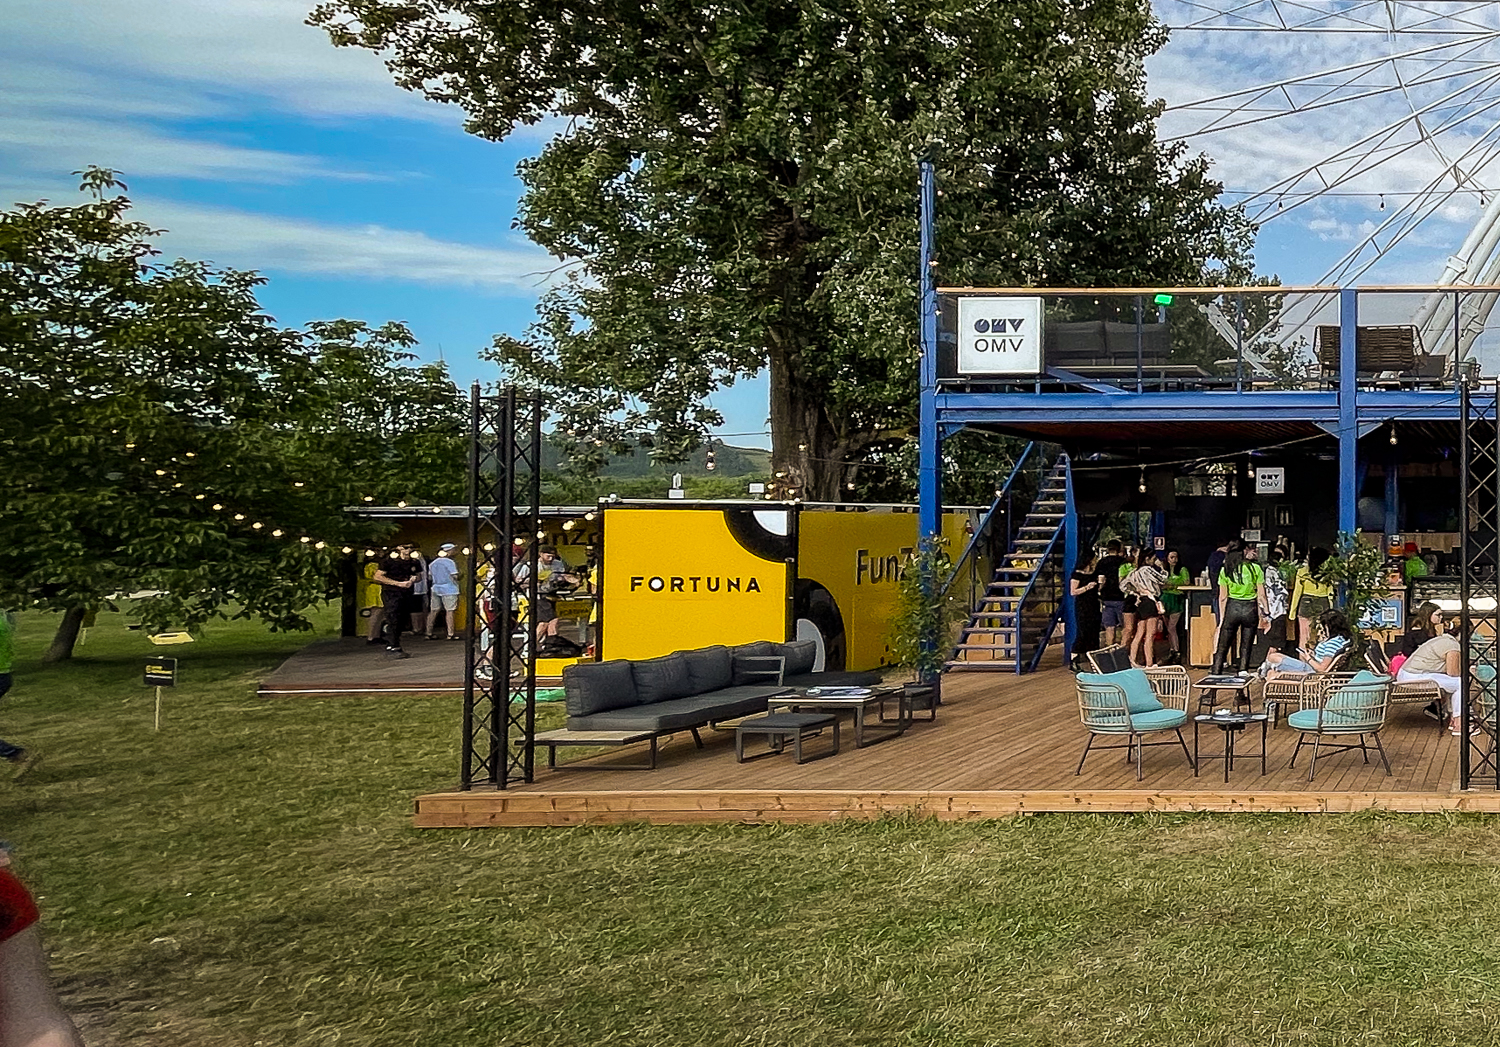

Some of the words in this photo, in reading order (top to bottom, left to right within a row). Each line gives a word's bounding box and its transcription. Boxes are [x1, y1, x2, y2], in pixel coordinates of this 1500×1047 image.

[974, 318, 1025, 333] OMV
[974, 338, 1024, 353] OMV
[630, 576, 761, 593] FORTUNA
